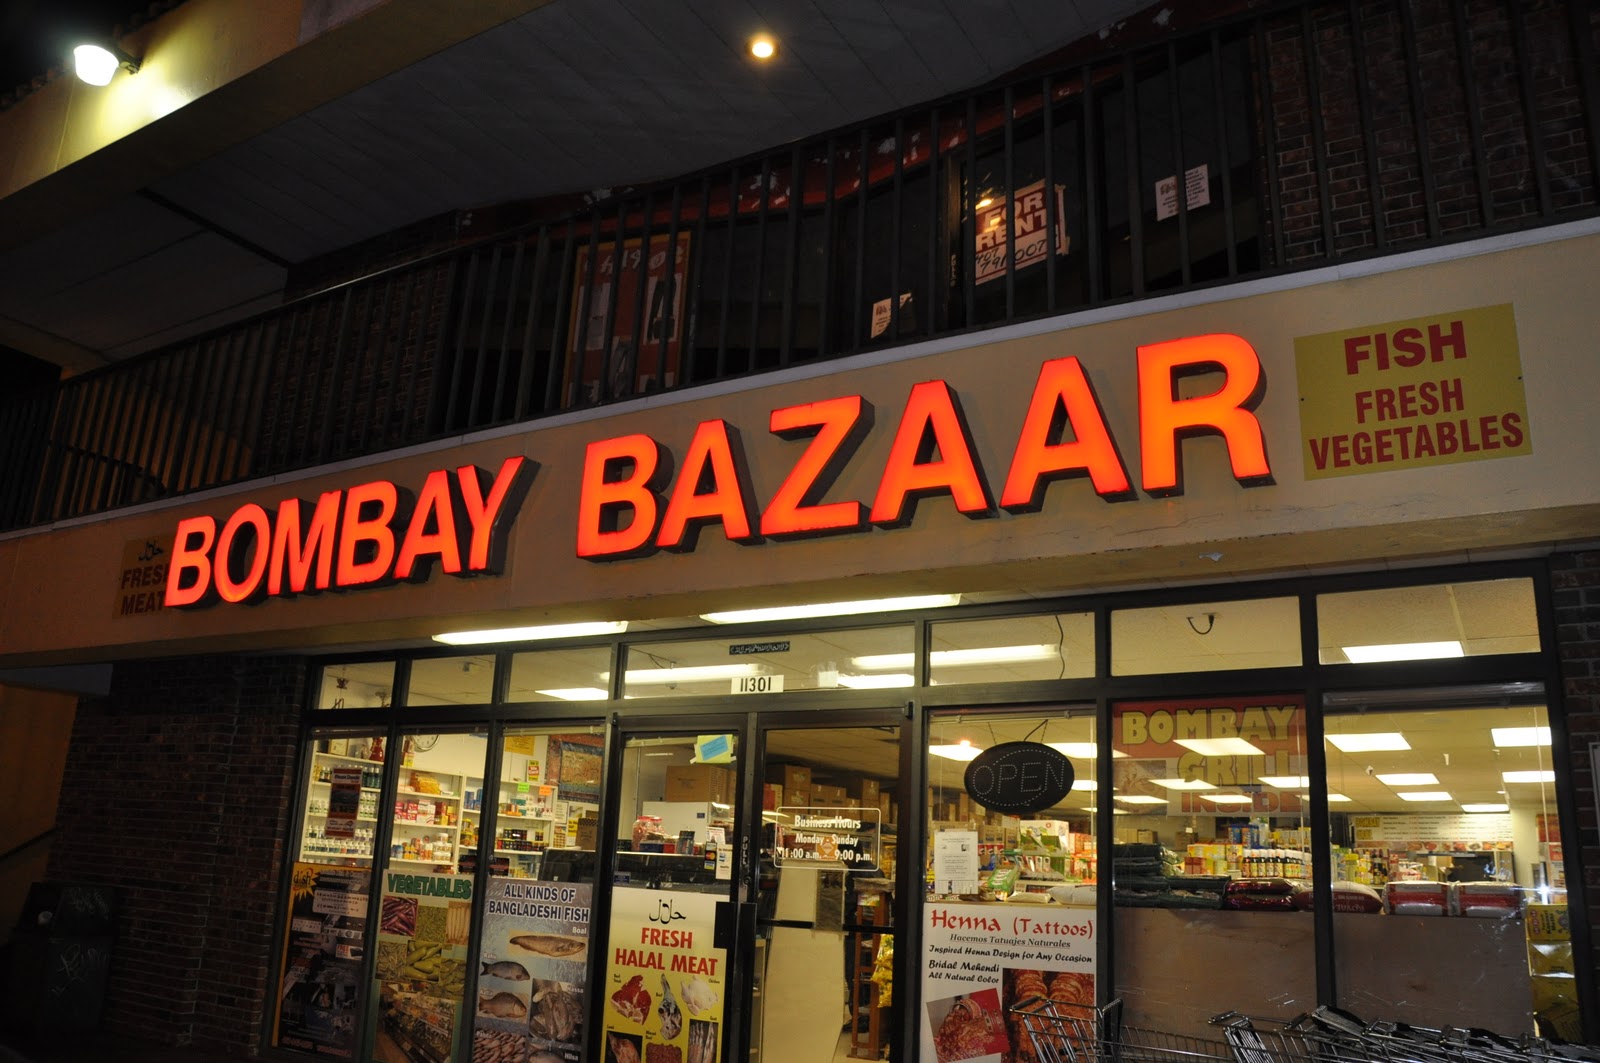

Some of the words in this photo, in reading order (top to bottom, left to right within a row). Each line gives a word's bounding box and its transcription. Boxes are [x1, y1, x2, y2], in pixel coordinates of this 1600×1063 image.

[984, 191, 1043, 229] FOR
[976, 208, 1047, 252] RENT
[1344, 320, 1467, 375] FISH
[1355, 378, 1464, 424] FRESH
[1309, 412, 1524, 470] VEGETABLES
[164, 455, 530, 607] BOMBAY
[576, 332, 1274, 559] BAZAAR
[120, 590, 165, 616] MEAT
[740, 676, 772, 692] 11301
[1121, 704, 1298, 745] BOMBAY
[972, 760, 1065, 796] OPEN
[1177, 749, 1293, 787] GRILL
[1180, 791, 1304, 813] INSIDE
[794, 814, 832, 829] Business
[834, 815, 861, 829] Hours
[795, 833, 824, 845] Monday
[831, 834, 859, 847] Sunday
[781, 848, 804, 860] 11:00
[834, 849, 854, 860] 9:00
[855, 853, 873, 862] p.m.
[387, 873, 472, 900] VEGETABLES
[504, 884, 523, 899] ALL
[525, 886, 558, 901] KINDS
[561, 888, 576, 903] OF
[488, 900, 561, 920] BANGLADESHI
[564, 907, 590, 922] FISH
[648, 898, 687, 924] حلال
[572, 926, 587, 934] Boal
[930, 909, 1002, 932] Henna
[1013, 917, 1093, 940] (Tattoos)
[641, 927, 693, 949] FRESH
[950, 933, 988, 943] Hacemos
[990, 936, 1026, 946] Tatuajes
[1027, 938, 1071, 948] Naturales
[615, 947, 665, 971] HALAL
[670, 954, 718, 977] MEAT
[928, 959, 958, 970] Bridal
[960, 961, 1000, 973] Mehendi
[929, 945, 963, 956] Inspired
[964, 947, 991, 957] Henna
[993, 949, 1020, 961] Design
[1021, 951, 1034, 961] for
[1036, 952, 1053, 962] Any
[1055, 953, 1092, 963] Occasion
[944, 973, 976, 982] Natural
[977, 975, 999, 984] Color
